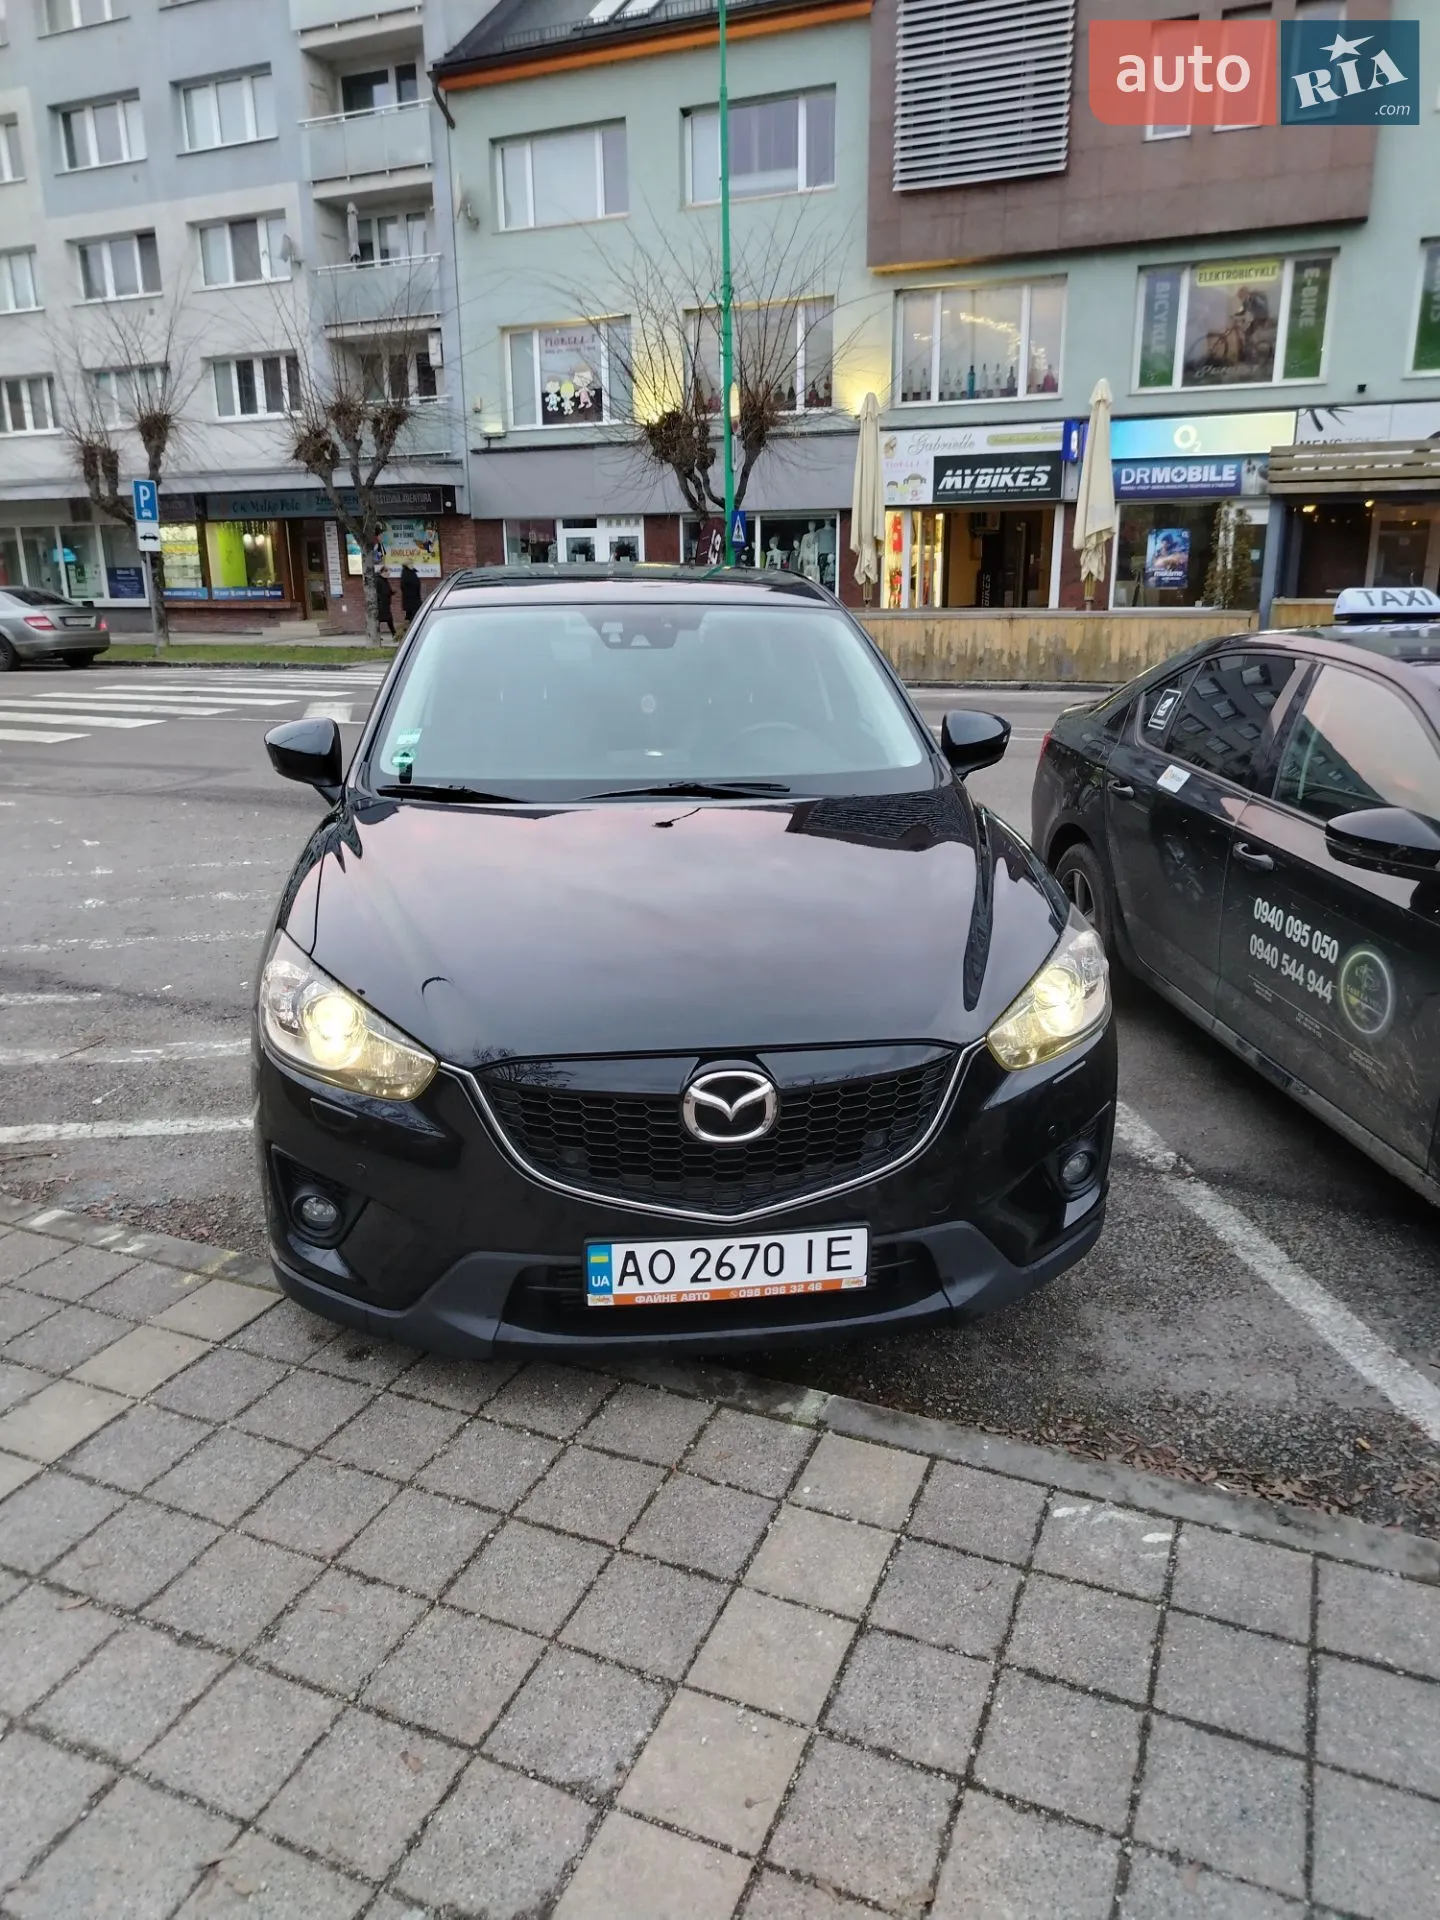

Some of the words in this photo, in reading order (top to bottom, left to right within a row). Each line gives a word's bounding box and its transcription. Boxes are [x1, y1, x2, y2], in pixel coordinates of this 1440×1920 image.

[1198, 265, 1277, 283] ELEKTROBICYKLE
[1299, 267, 1321, 328] E-BIKE
[1151, 282, 1171, 355] BICYKLE
[937, 465, 1052, 490] MYBIKES
[1120, 464, 1238, 485] DRMOBILE
[139, 484, 150, 508] P
[1356, 589, 1434, 607] TAXI
[1253, 897, 1284, 932] 0940
[1285, 915, 1312, 948] 095
[1312, 930, 1339, 964] 050
[1249, 933, 1278, 969] 0940
[1280, 953, 1304, 986] 544
[1307, 969, 1333, 1004] 944
[617, 1249, 676, 1286] AO
[689, 1241, 785, 1284] 2670
[806, 1235, 853, 1275] IE
[591, 1275, 610, 1287] UA
[789, 1284, 805, 1294] 32
[634, 1292, 678, 1304] ФАЙНЕ
[680, 1291, 710, 1302] АВТО
